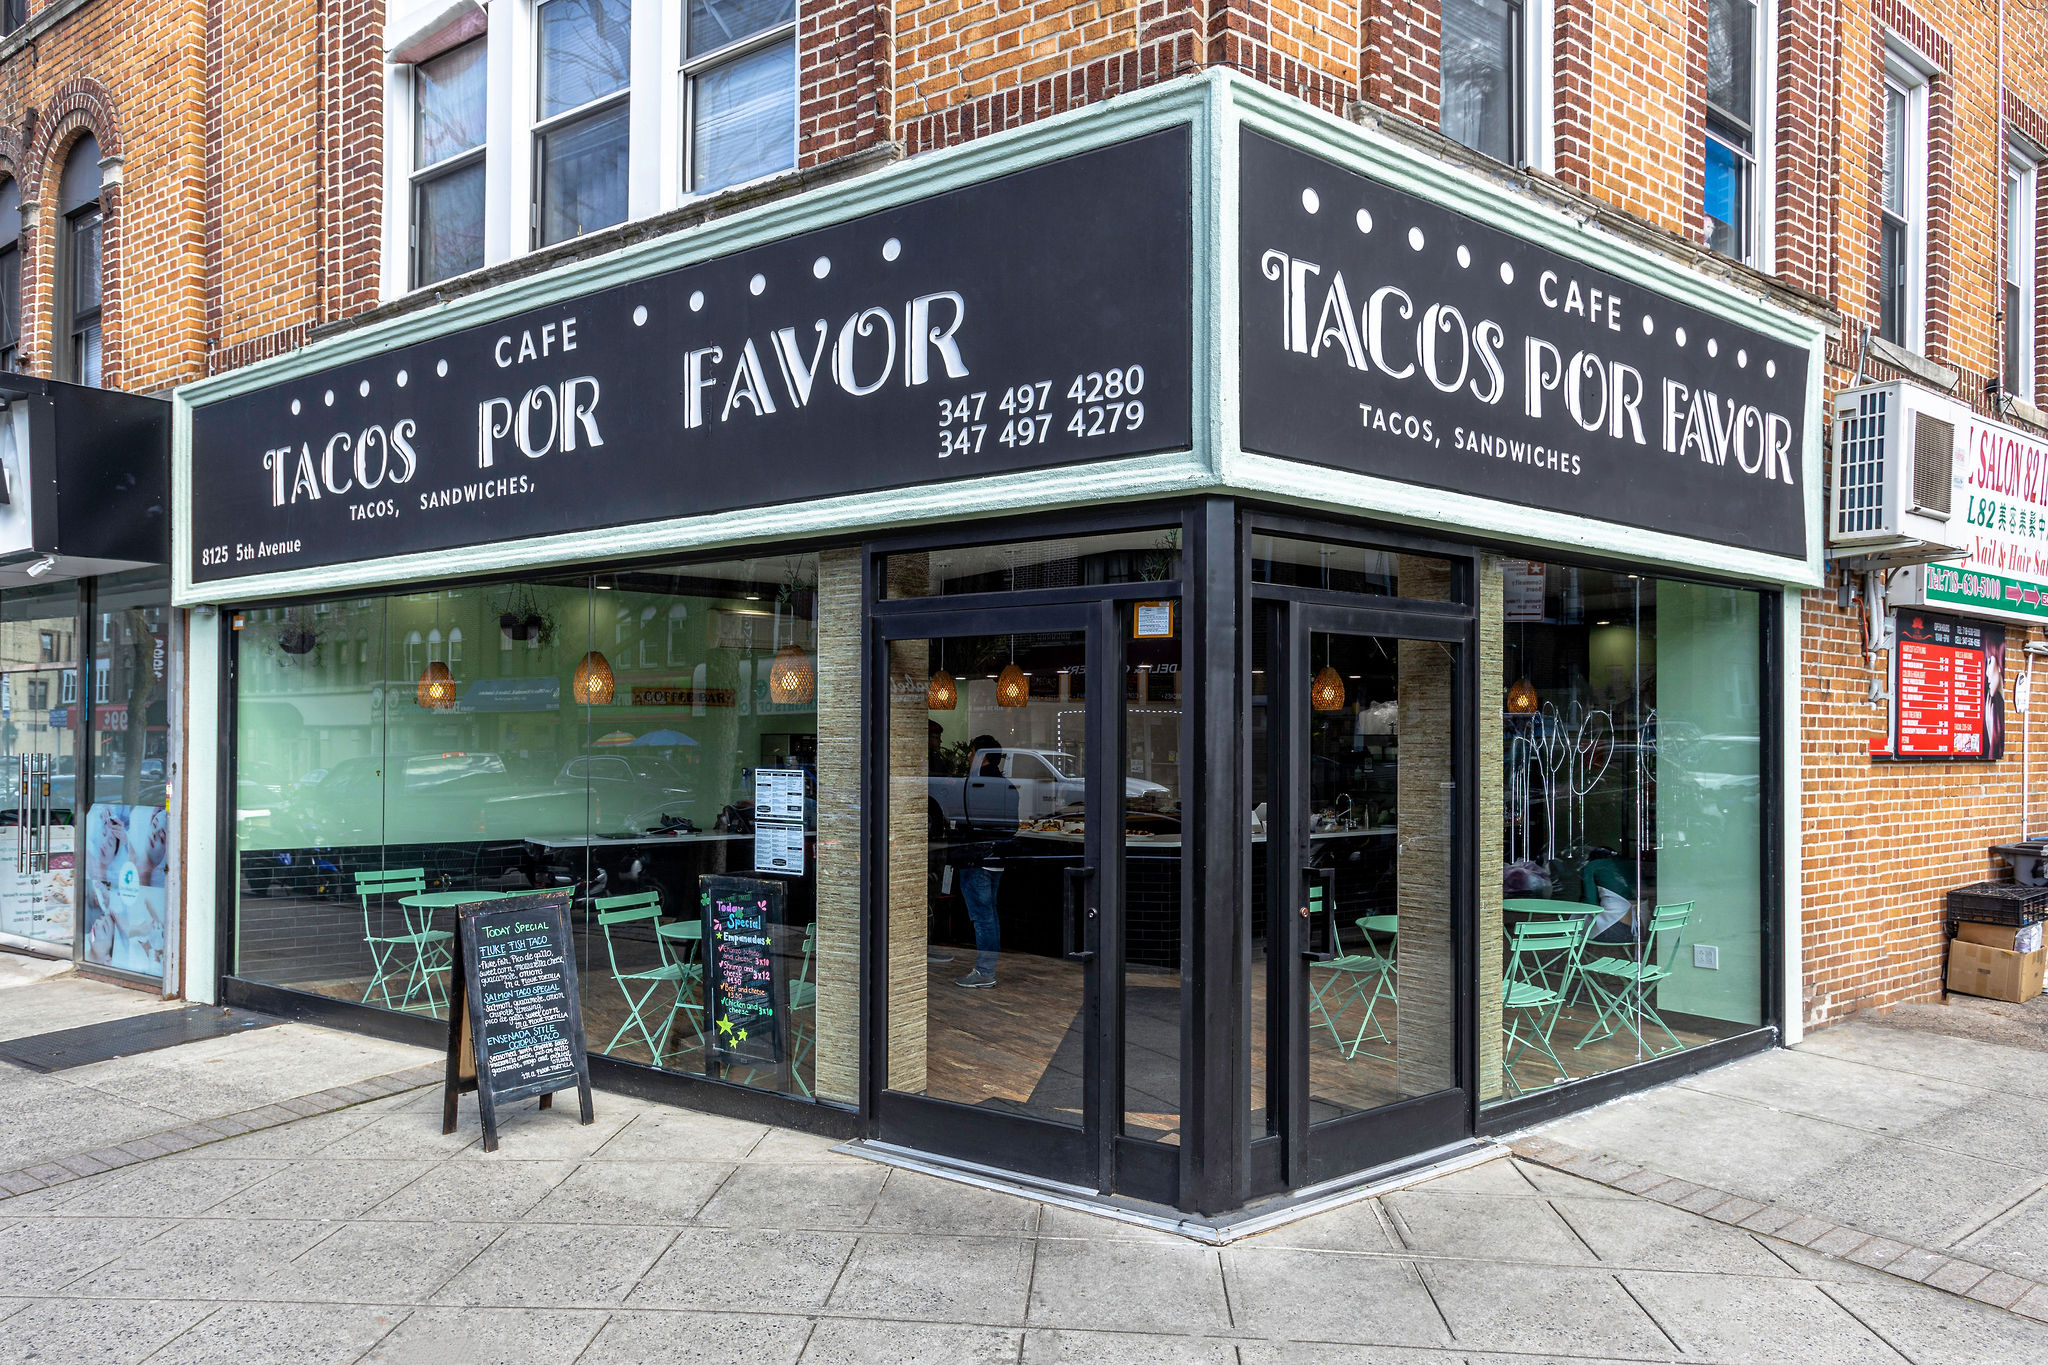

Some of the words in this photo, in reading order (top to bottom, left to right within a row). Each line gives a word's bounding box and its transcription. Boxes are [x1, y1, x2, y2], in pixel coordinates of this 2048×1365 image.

[1539, 269, 1622, 332] CAFE
[494, 316, 577, 368] CAFE
[1261, 247, 1505, 405] TACOS
[1524, 335, 1647, 446] POR
[1662, 377, 1794, 485] FAVOR
[262, 418, 417, 508] TACOS
[478, 375, 605, 468] POR
[683, 290, 970, 429] FAVOR
[938, 391, 987, 427] 347
[998, 380, 1053, 416] 497
[1067, 364, 1145, 405] 4280
[938, 423, 987, 459] 347
[998, 413, 1053, 448] 497
[1067, 399, 1145, 438] 4279
[1359, 402, 1441, 448] TACOS,
[1454, 426, 1581, 476] SANDWICHES
[1977, 430, 2024, 498] SALON
[2023, 446, 2040, 503] 82
[349, 498, 400, 521] TACOS,
[420, 475, 536, 510] SANDWICHES,
[1967, 495, 1996, 529] L82
[202, 545, 229, 566] 8125
[236, 543, 255, 562] 5th
[258, 538, 302, 557] Avenue
[2008, 544, 2032, 574] Hair
[641, 690, 694, 703] COFFEE
[698, 691, 726, 703] BAR
[514, 921, 549, 934] SPECIAL
[727, 913, 761, 930] Special
[478, 944, 507, 957] FLUKE
[526, 935, 548, 947] TACO
[484, 990, 514, 1002] SALMON
[532, 984, 560, 994] SPECIAL
[486, 1029, 531, 1046] ENSENADA
[537, 1031, 560, 1042] TACO
